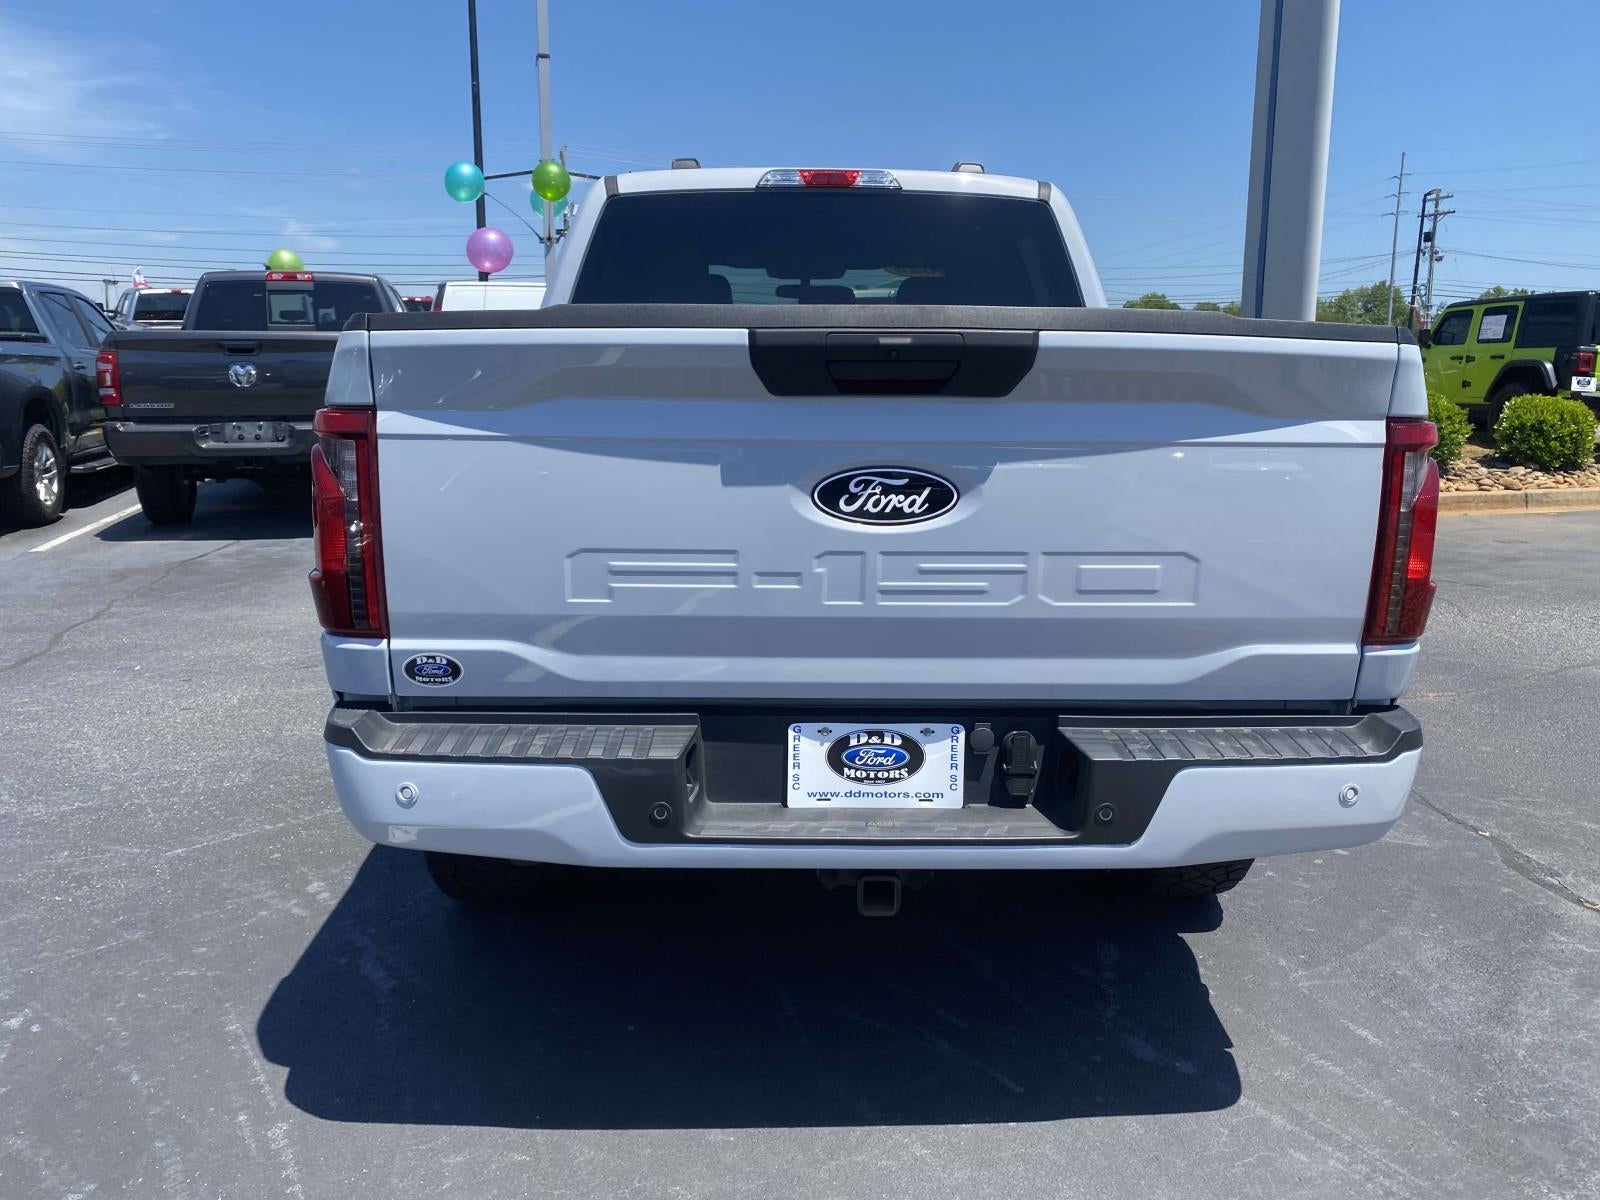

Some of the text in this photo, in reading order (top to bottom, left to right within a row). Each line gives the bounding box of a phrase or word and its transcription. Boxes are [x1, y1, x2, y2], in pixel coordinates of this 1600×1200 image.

[838, 475, 932, 514] Ford
[564, 548, 1201, 607] F-150
[416, 656, 447, 664] D&D
[421, 666, 444, 674] Ford
[848, 731, 902, 746] D&D
[792, 725, 802, 791] GREER SC
[855, 749, 896, 765] Ford
[949, 726, 960, 791] GREER SC
[843, 767, 909, 779] MOTORS
[806, 790, 944, 799] www.ddmotors.com
